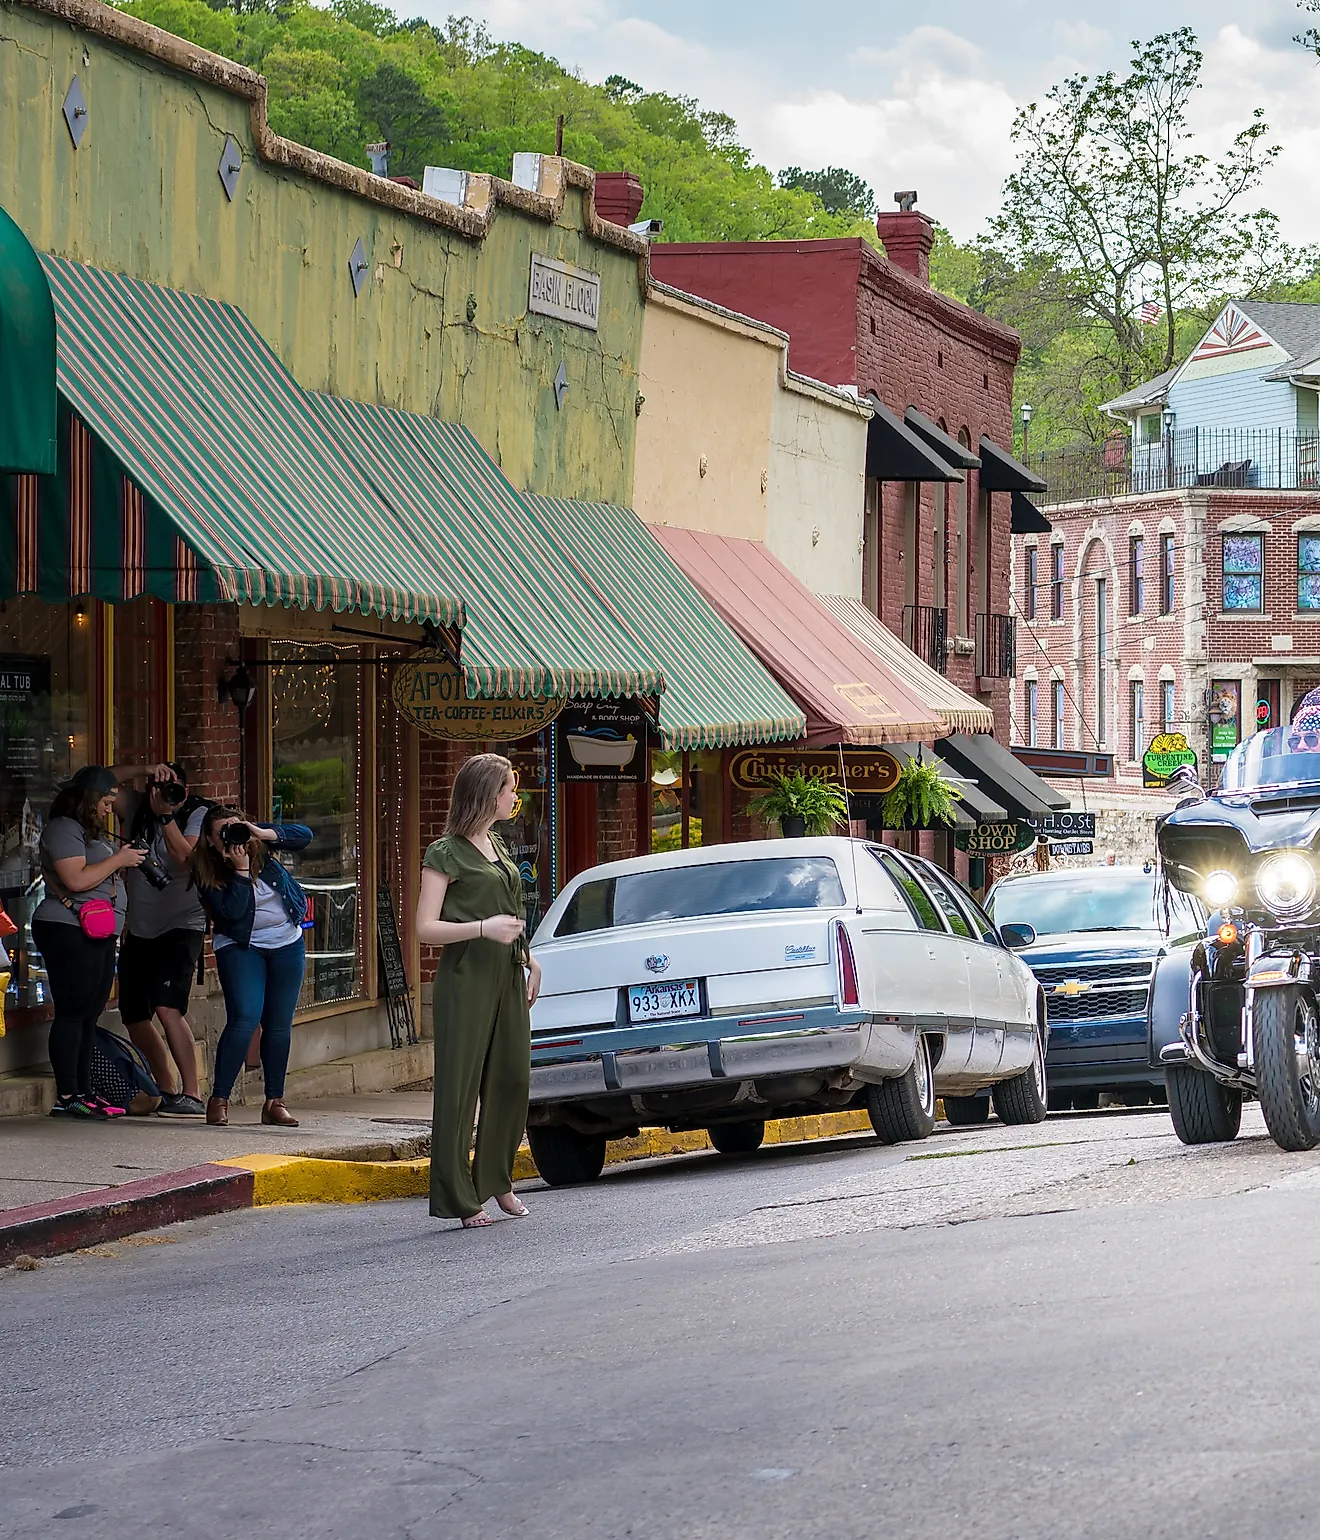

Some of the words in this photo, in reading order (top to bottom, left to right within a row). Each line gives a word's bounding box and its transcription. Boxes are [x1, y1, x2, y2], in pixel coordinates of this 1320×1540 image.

[532, 269, 562, 306] BASIN
[564, 280, 597, 320] BLOCK
[13, 675, 31, 690] TUB
[739, 753, 890, 784] Christopher's
[968, 836, 1016, 850] SHOP
[1051, 842, 1091, 855] DOWNSTAIRS
[645, 983, 683, 995] Arkansas
[632, 994, 660, 1012] 933
[670, 990, 696, 1008] XKX
